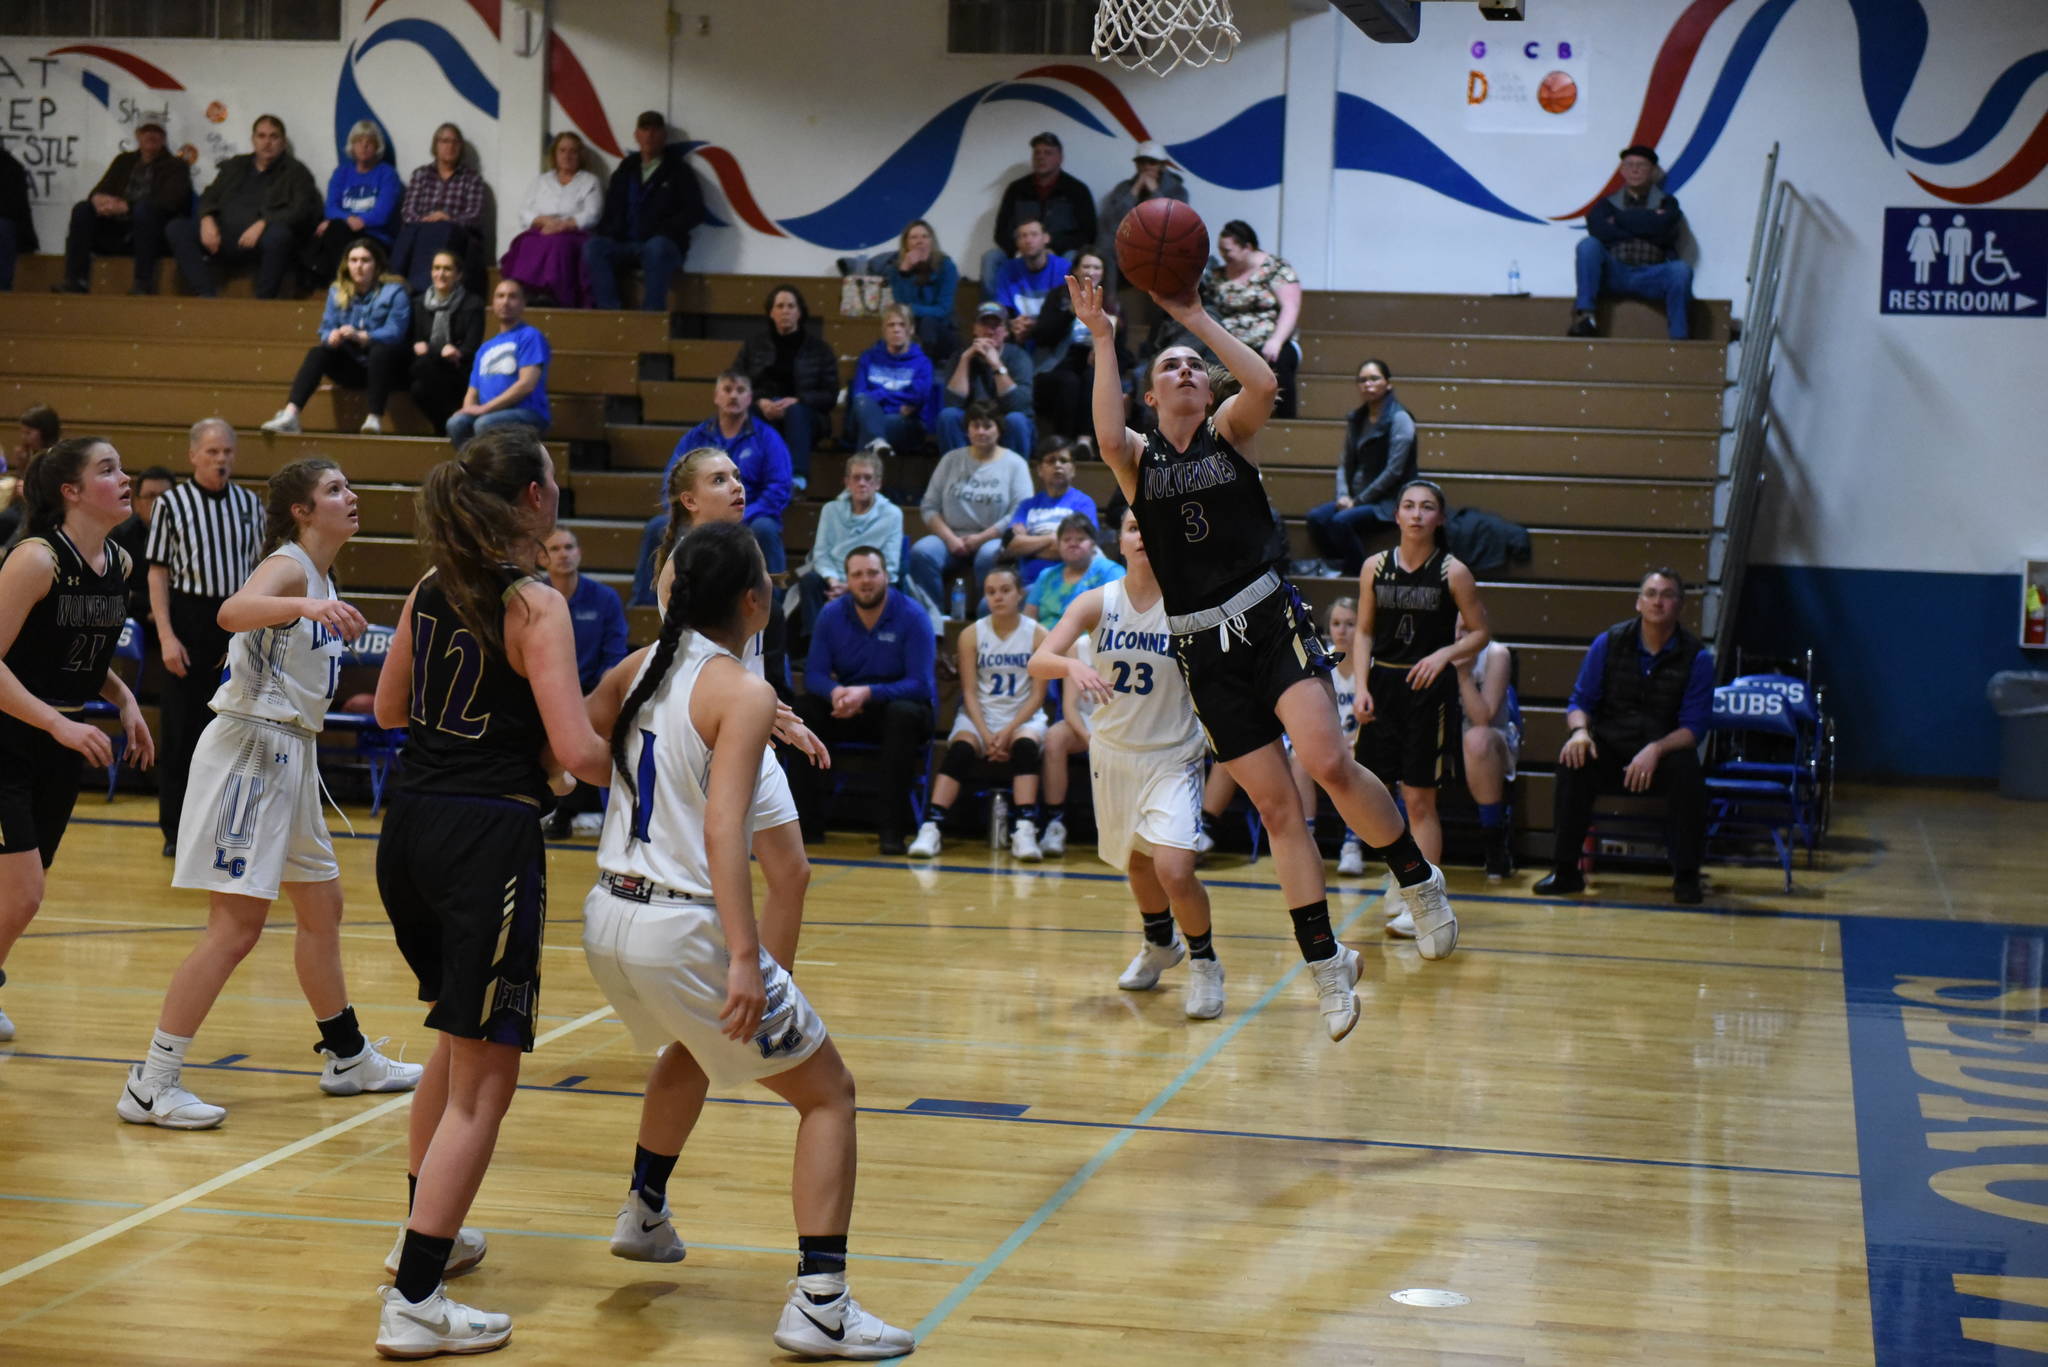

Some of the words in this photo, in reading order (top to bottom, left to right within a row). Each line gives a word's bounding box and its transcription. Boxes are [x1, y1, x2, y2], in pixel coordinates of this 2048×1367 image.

[1888, 289, 2010, 311] RESTROOM
[1144, 450, 1237, 500] WOLVERINES
[1181, 501, 1209, 543] 3
[1394, 613, 1416, 645] 4
[411, 611, 491, 739] 12
[989, 672, 1017, 697] 21
[1112, 660, 1154, 696] 23
[1712, 692, 1783, 716] CUBS
[213, 846, 247, 880] LC
